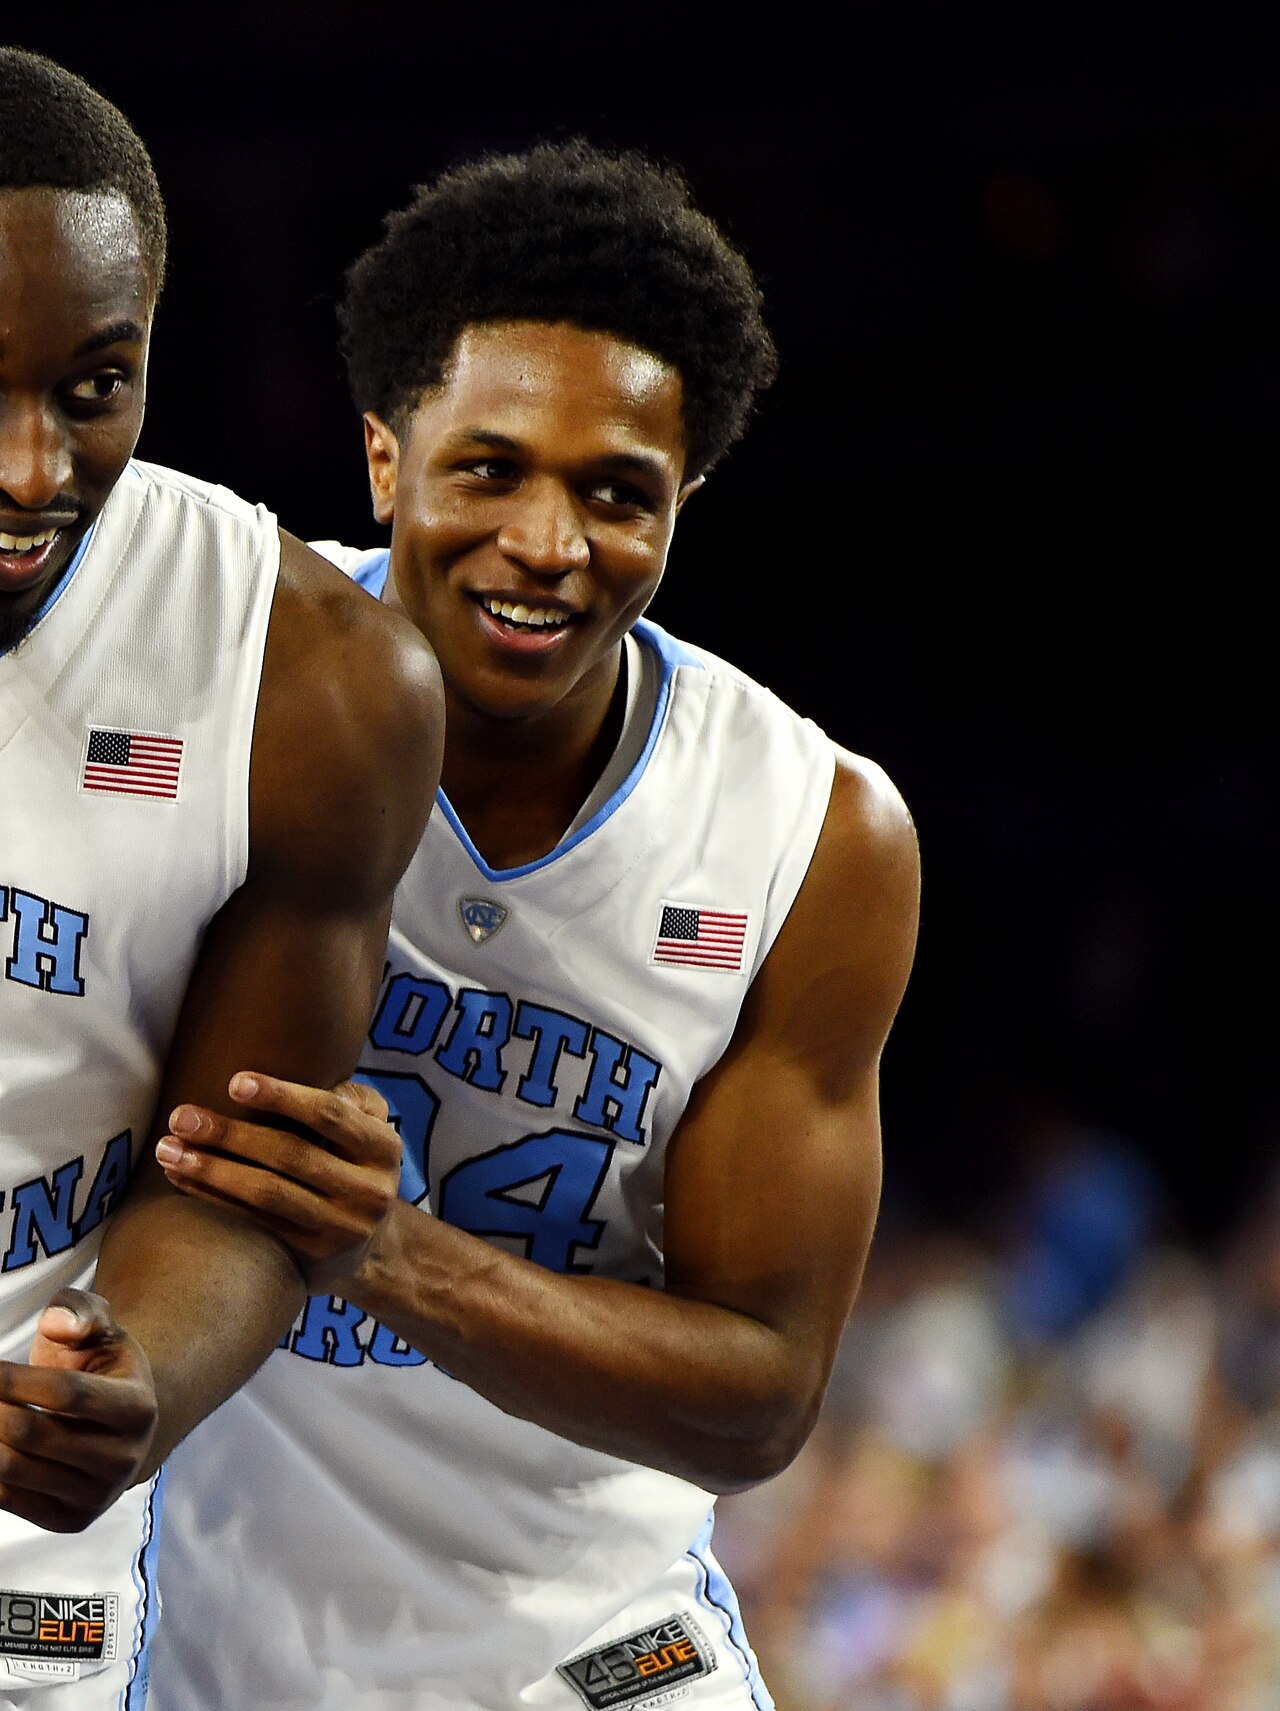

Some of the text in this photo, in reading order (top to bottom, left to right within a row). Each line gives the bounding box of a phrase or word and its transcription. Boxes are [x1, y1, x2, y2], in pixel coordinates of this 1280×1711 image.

[368, 960, 663, 1146] ORTH
[40, 1598, 104, 1621] NIKE
[39, 1619, 105, 1643] ELITE
[623, 1620, 687, 1659] NIKE
[30, 1643, 38, 1651] OF
[634, 1637, 698, 1678] ELITE
